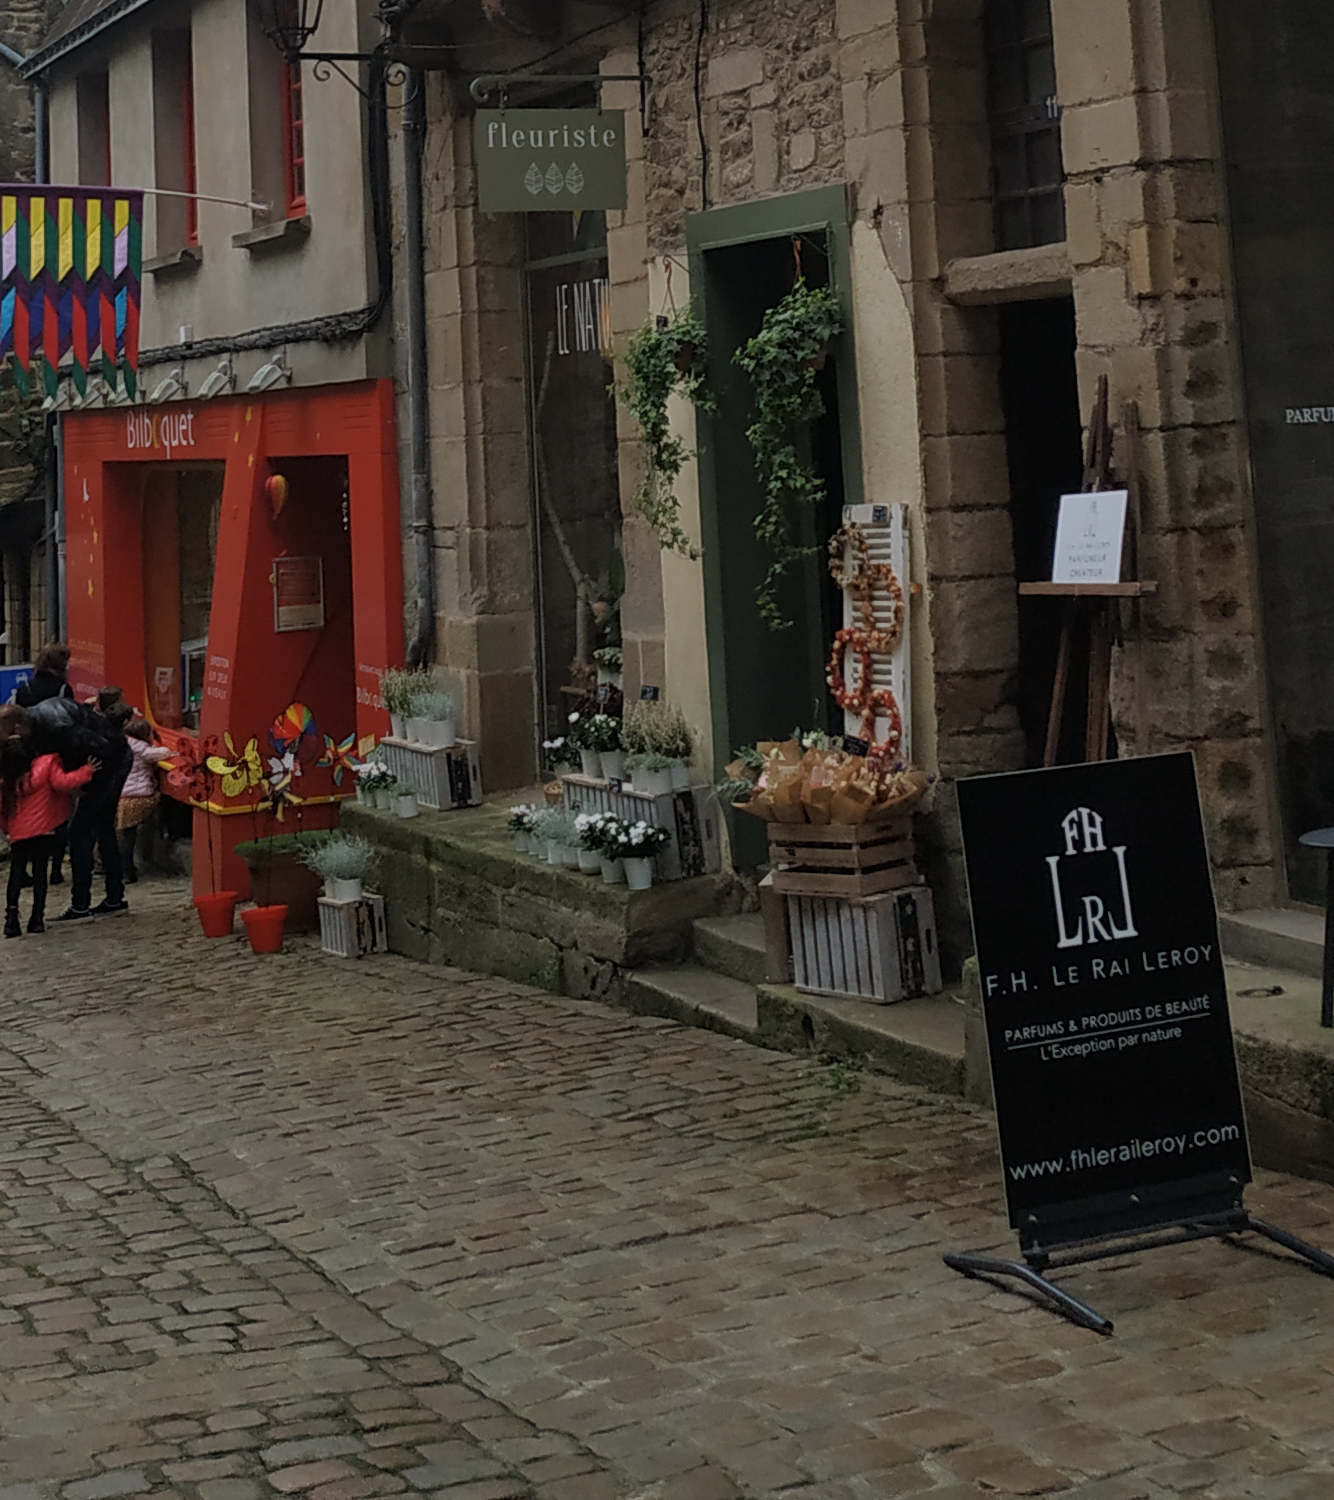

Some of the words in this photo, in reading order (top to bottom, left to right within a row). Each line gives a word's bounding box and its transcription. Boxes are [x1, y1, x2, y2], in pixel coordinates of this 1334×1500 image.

[487, 121, 616, 148] fleuriste
[556, 283, 570, 355] LE
[985, 969, 1039, 997] F.H.
[1052, 965, 1080, 987] LE
[1091, 958, 1131, 980] RAI
[1142, 945, 1213, 972] LEROY
[1004, 1021, 1065, 1043] PARFUMS
[1068, 1019, 1079, 1033] &
[1081, 1008, 1143, 1031] PRODUITS
[1145, 1003, 1163, 1019] DE
[1165, 994, 1211, 1016] BEAUTÉ
[1040, 1037, 1116, 1062] L'Exception
[1117, 1033, 1140, 1051] par
[1142, 1025, 1183, 1043] nature
[1009, 1124, 1240, 1182] www.fhleraileroy.com
